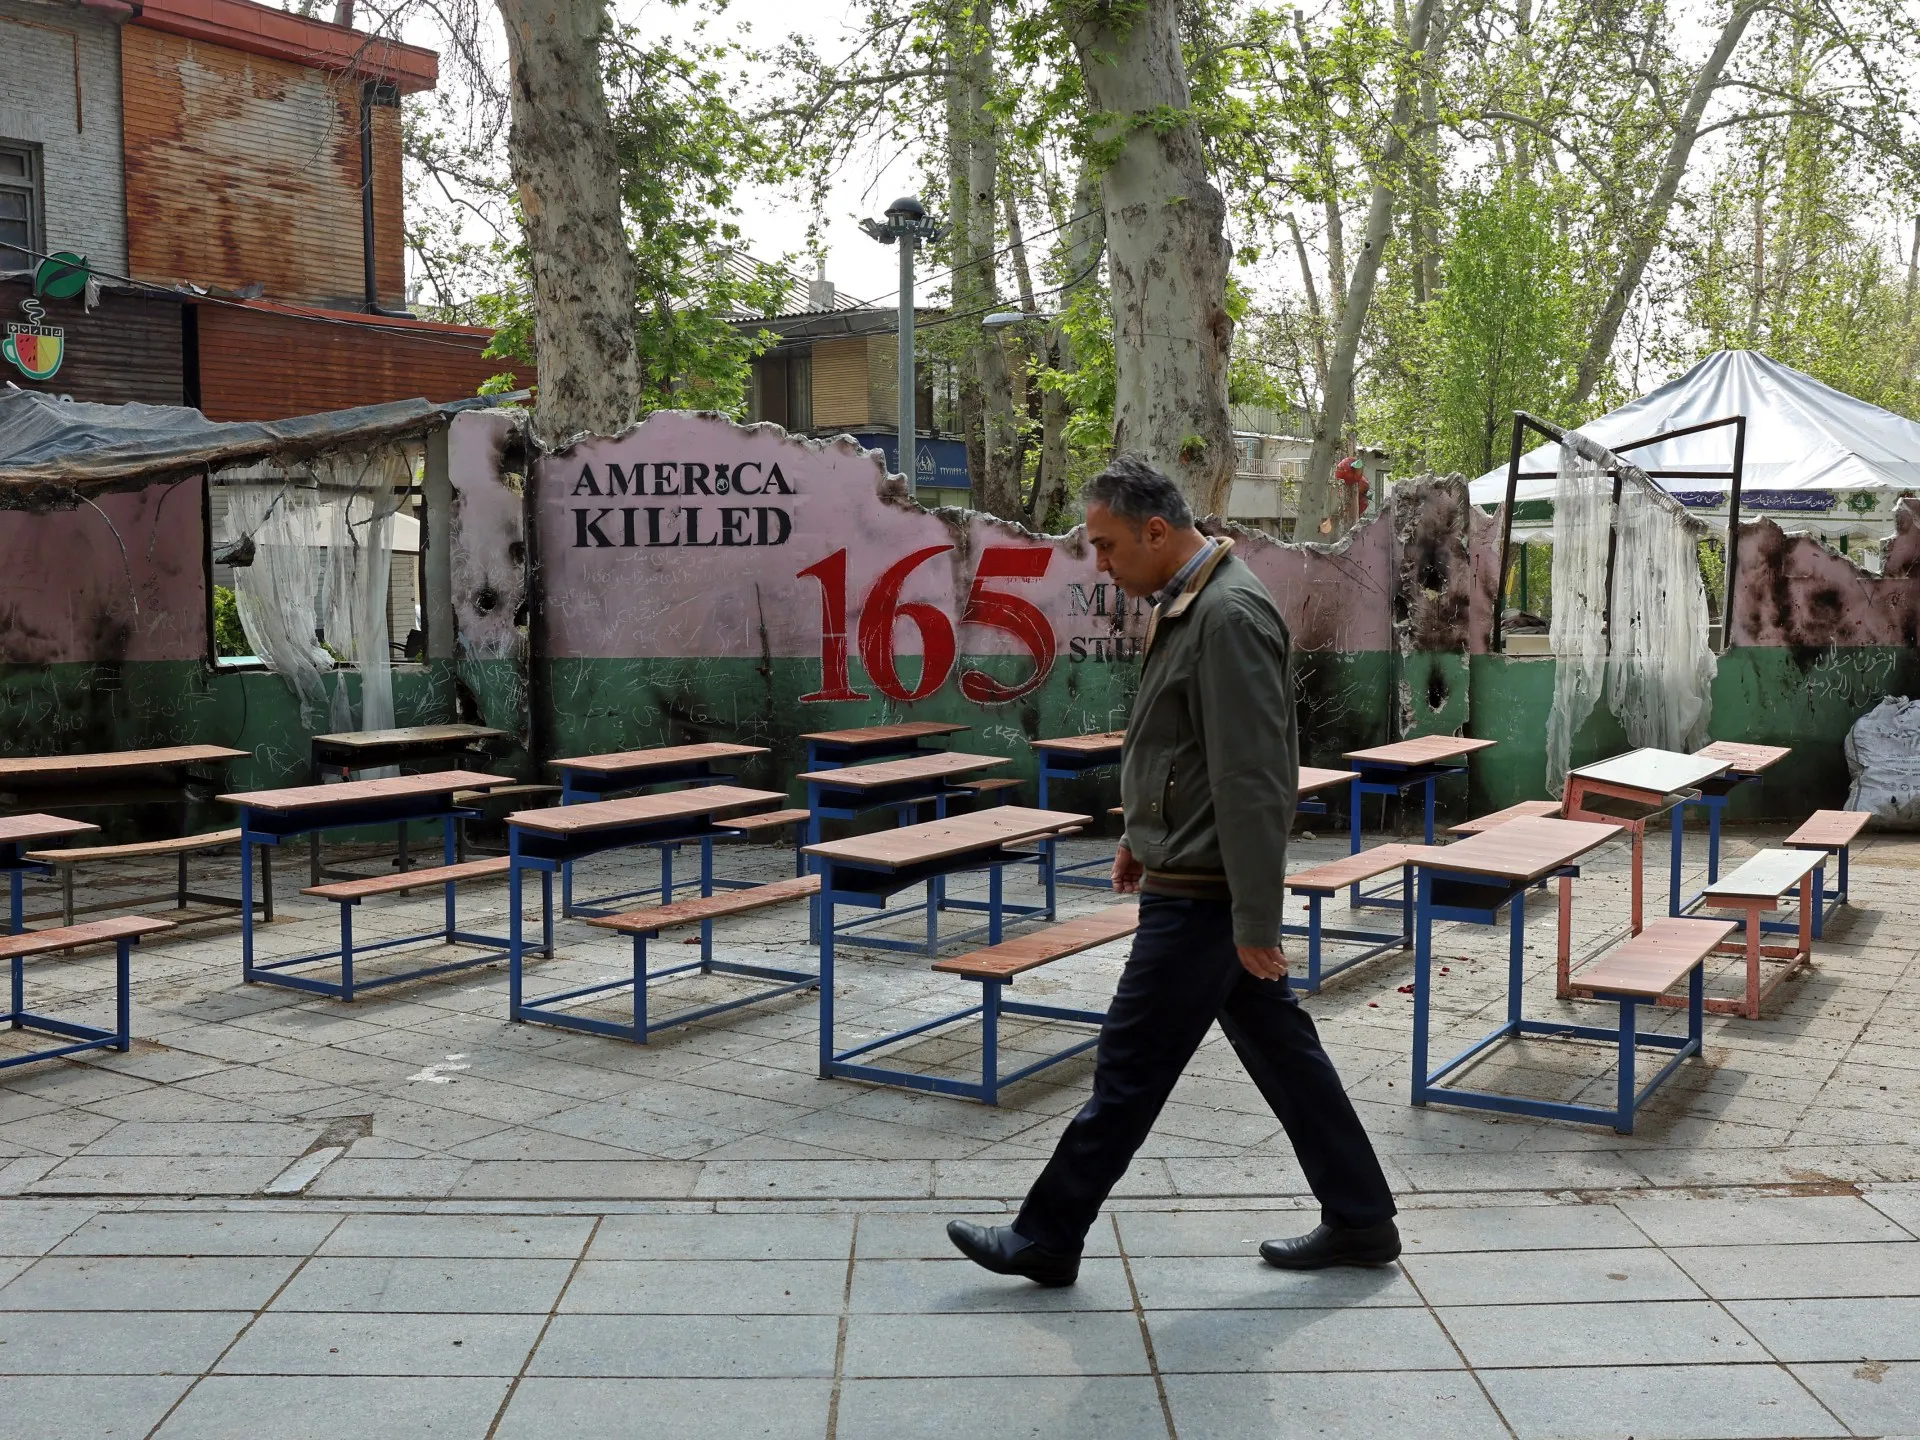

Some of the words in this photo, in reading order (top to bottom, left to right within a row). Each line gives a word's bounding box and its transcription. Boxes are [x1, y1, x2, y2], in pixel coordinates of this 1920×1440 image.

[571, 462, 794, 496] AMERICA
[571, 506, 792, 548] KILLED
[796, 544, 1056, 704] 165
